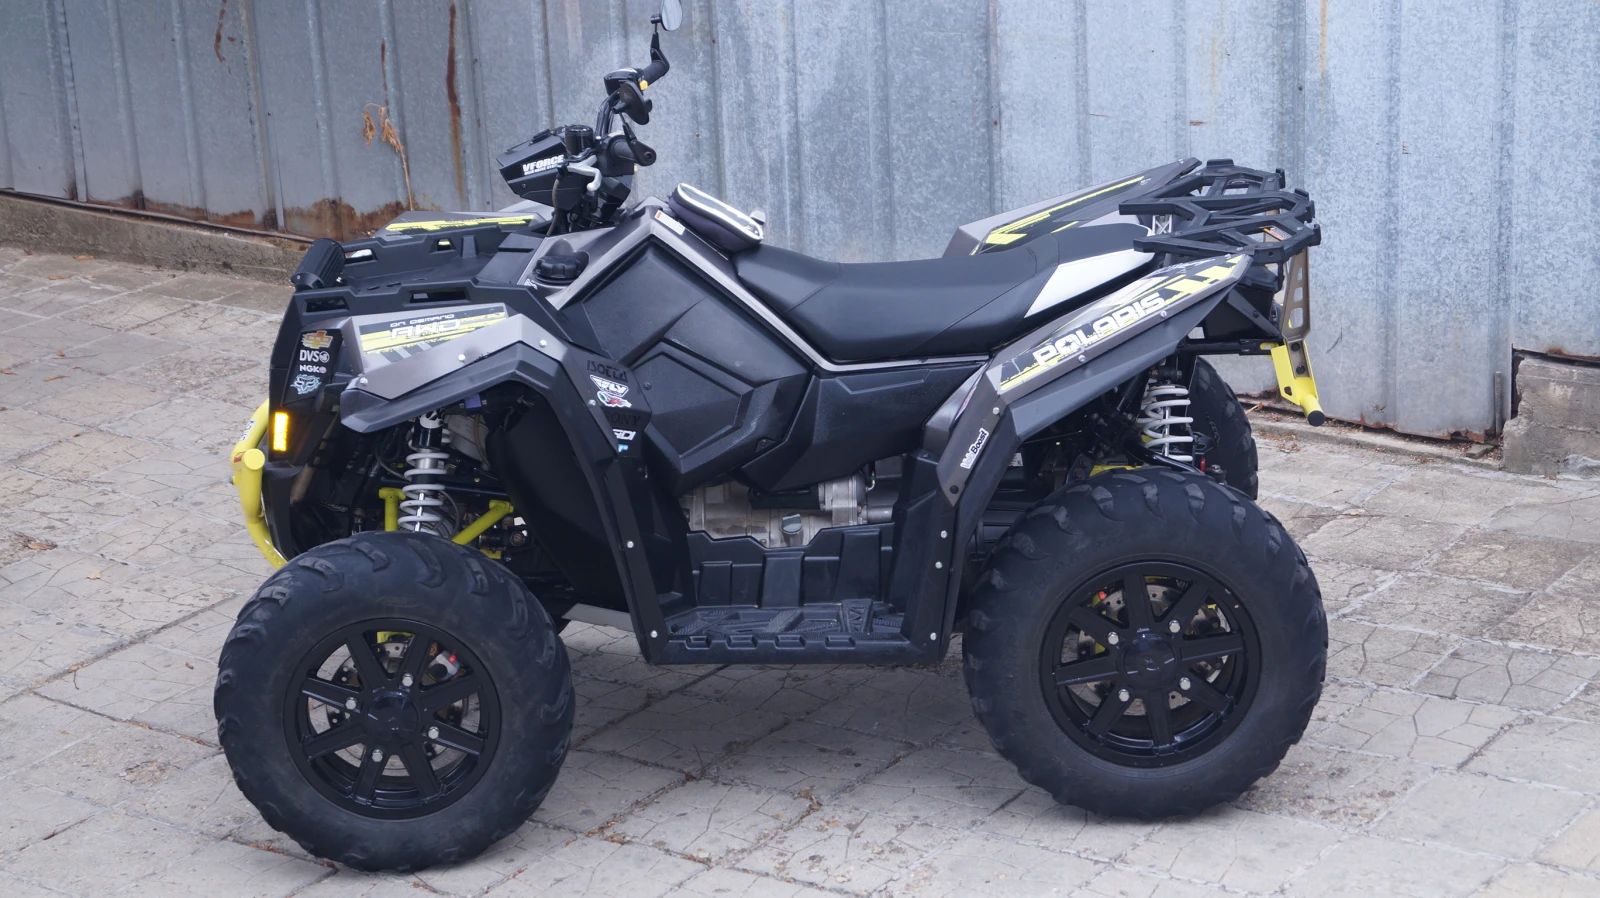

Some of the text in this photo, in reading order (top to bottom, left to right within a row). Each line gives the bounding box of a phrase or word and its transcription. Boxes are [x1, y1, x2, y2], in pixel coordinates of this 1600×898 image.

[522, 154, 565, 173] VFORCE
[410, 313, 455, 325] DEMAND
[391, 318, 460, 340] AWD
[1032, 291, 1167, 367] POLARIS
[299, 349, 320, 362] DVS
[299, 364, 320, 373] NGK
